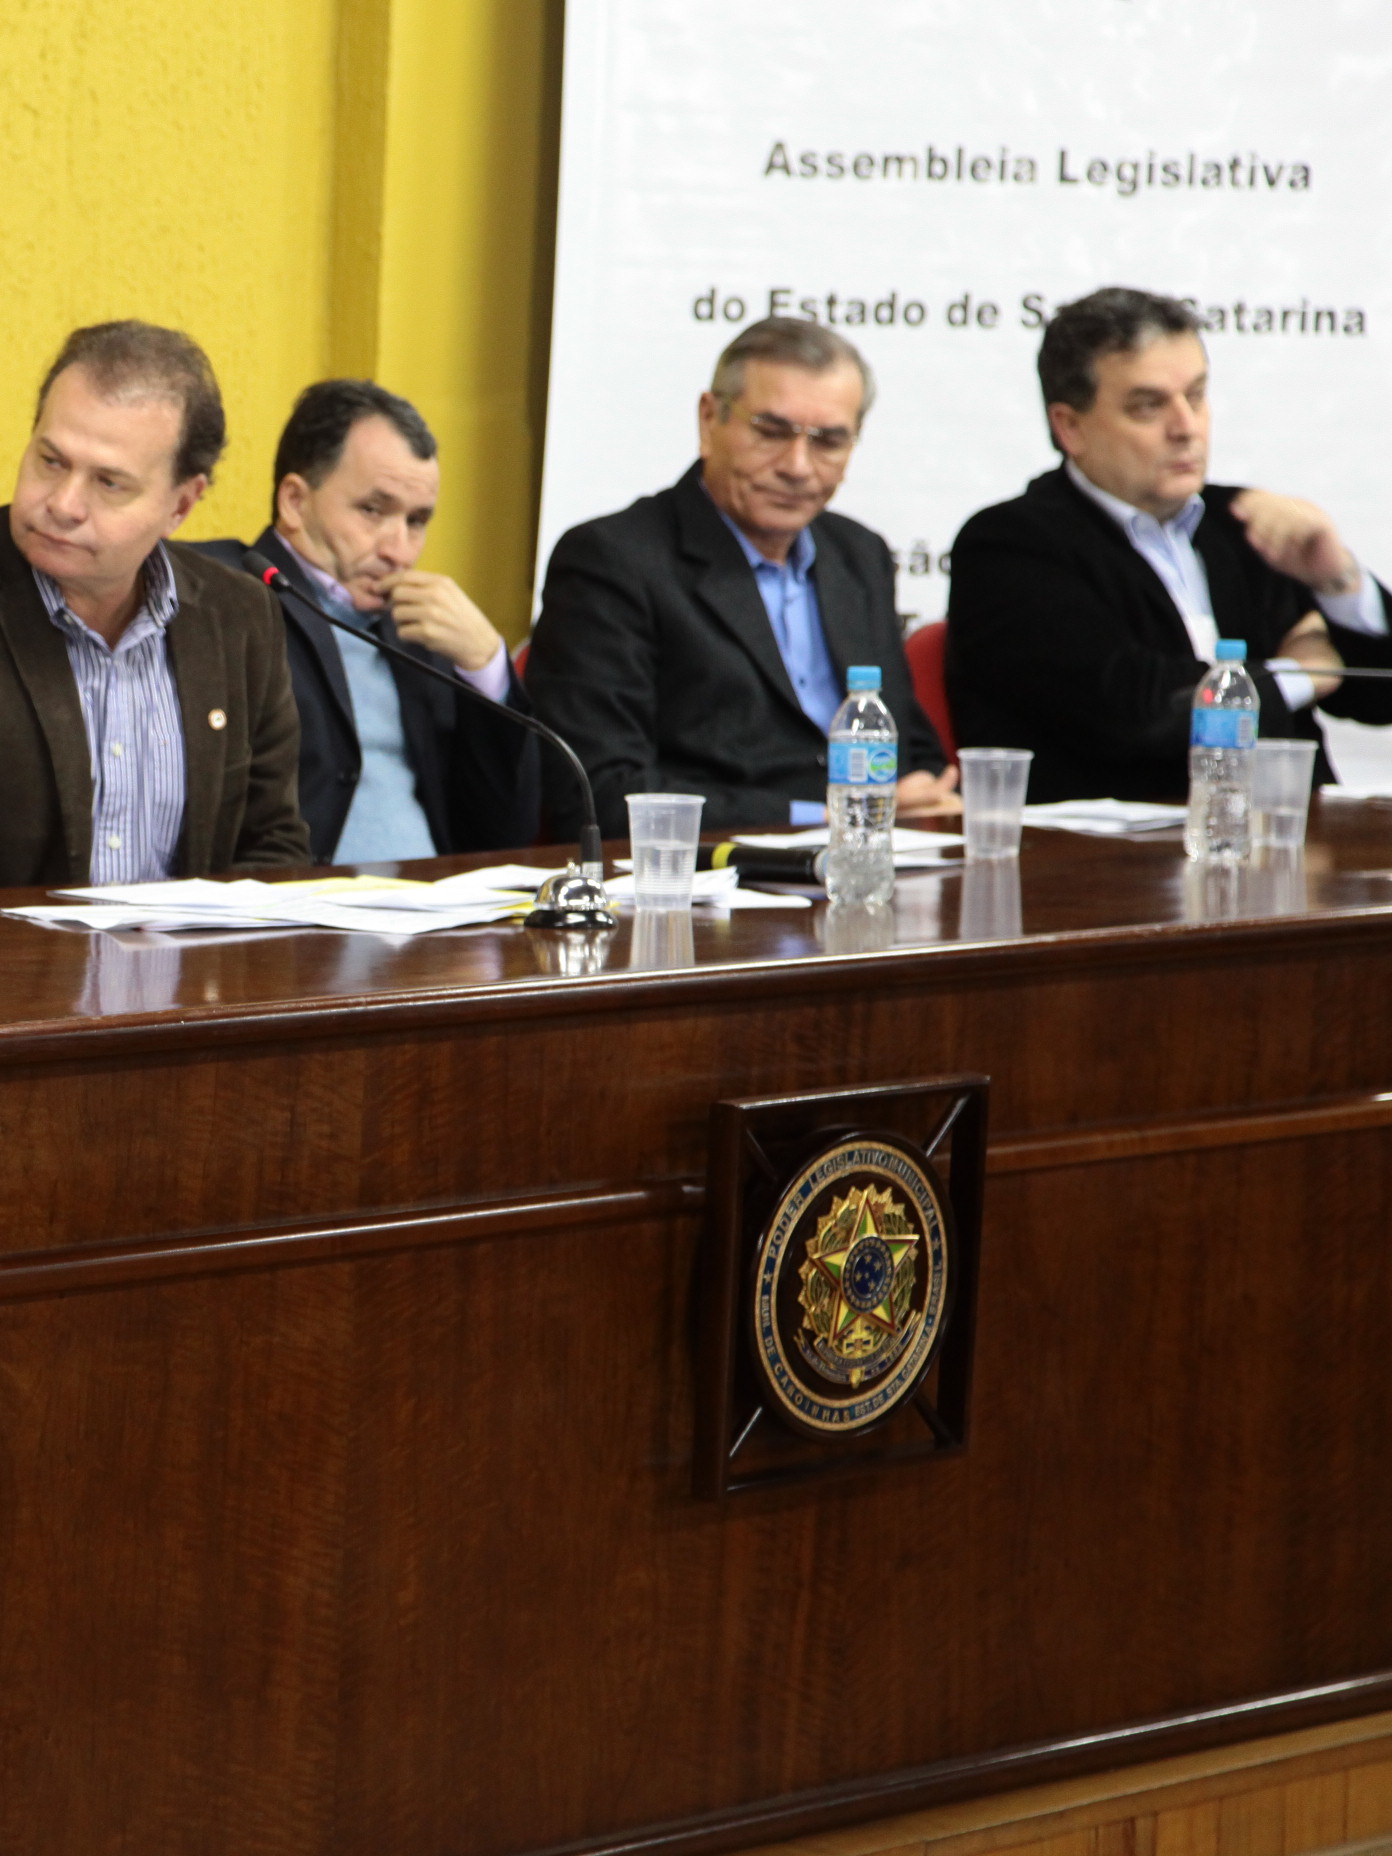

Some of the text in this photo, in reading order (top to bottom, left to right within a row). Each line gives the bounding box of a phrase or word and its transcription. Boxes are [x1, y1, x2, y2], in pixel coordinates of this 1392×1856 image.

[764, 141, 1312, 197] Assembleia Legislativa
[692, 287, 746, 323] do
[768, 288, 926, 327] Estado
[946, 292, 1000, 328] de
[768, 1150, 938, 1257] PODER LEGISLATIVO MUNICIPAL
[765, 1336, 776, 1356] DE
[774, 1362, 851, 1423] CANOINHAS
[872, 1395, 885, 1409] DE
[902, 1325, 932, 1380] CATARINA
[928, 1262, 943, 1315] BRASIL
